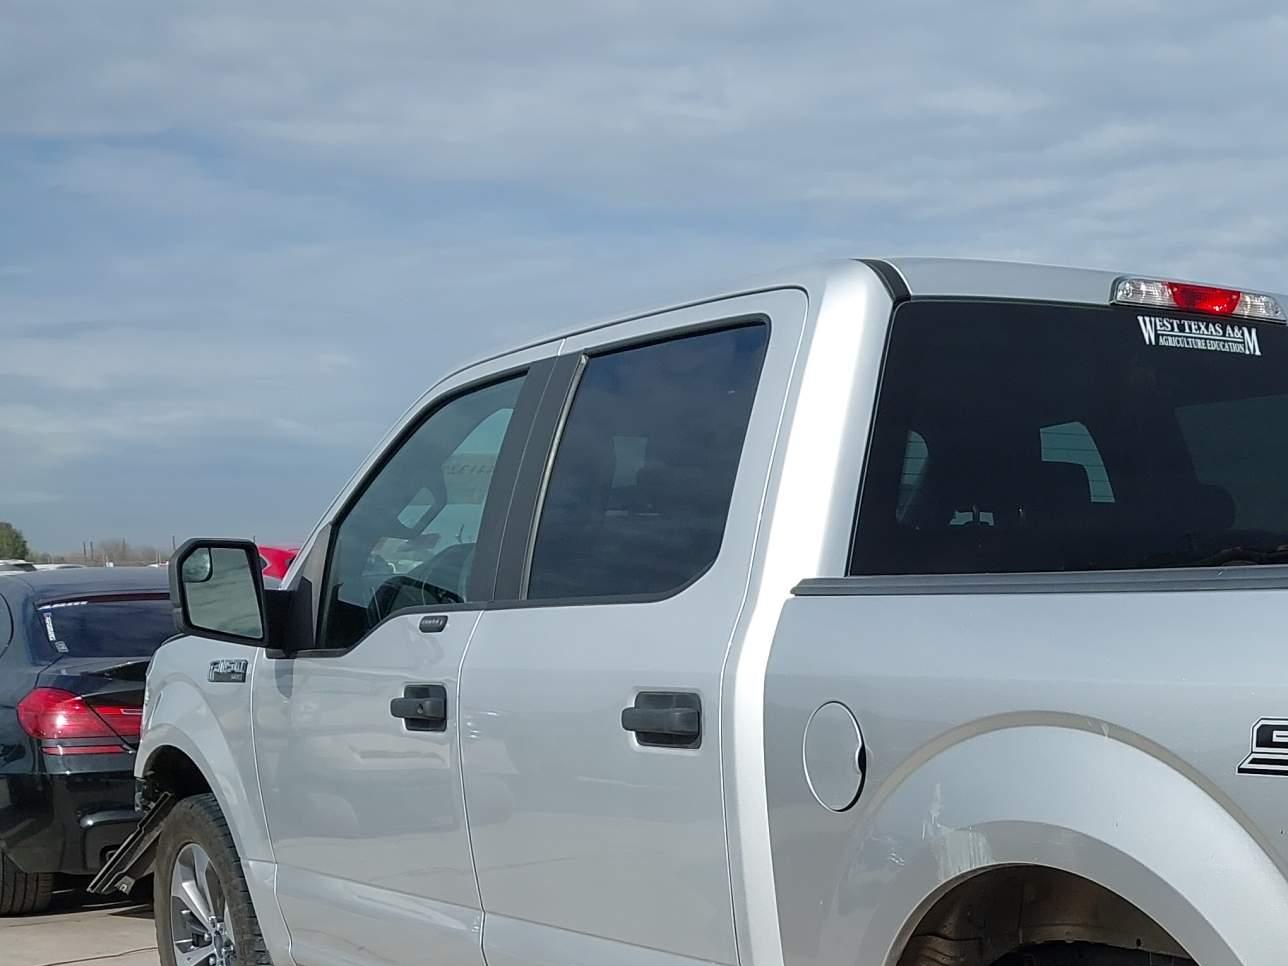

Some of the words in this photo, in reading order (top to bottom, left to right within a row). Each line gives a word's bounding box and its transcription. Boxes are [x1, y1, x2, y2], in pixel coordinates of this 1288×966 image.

[1137, 315, 1181, 345] WEST
[1181, 320, 1223, 337] TEXAS
[1226, 324, 1262, 355] A&M
[1158, 335, 1206, 349] AGRICULTURE
[1207, 340, 1245, 353] EDUCATION
